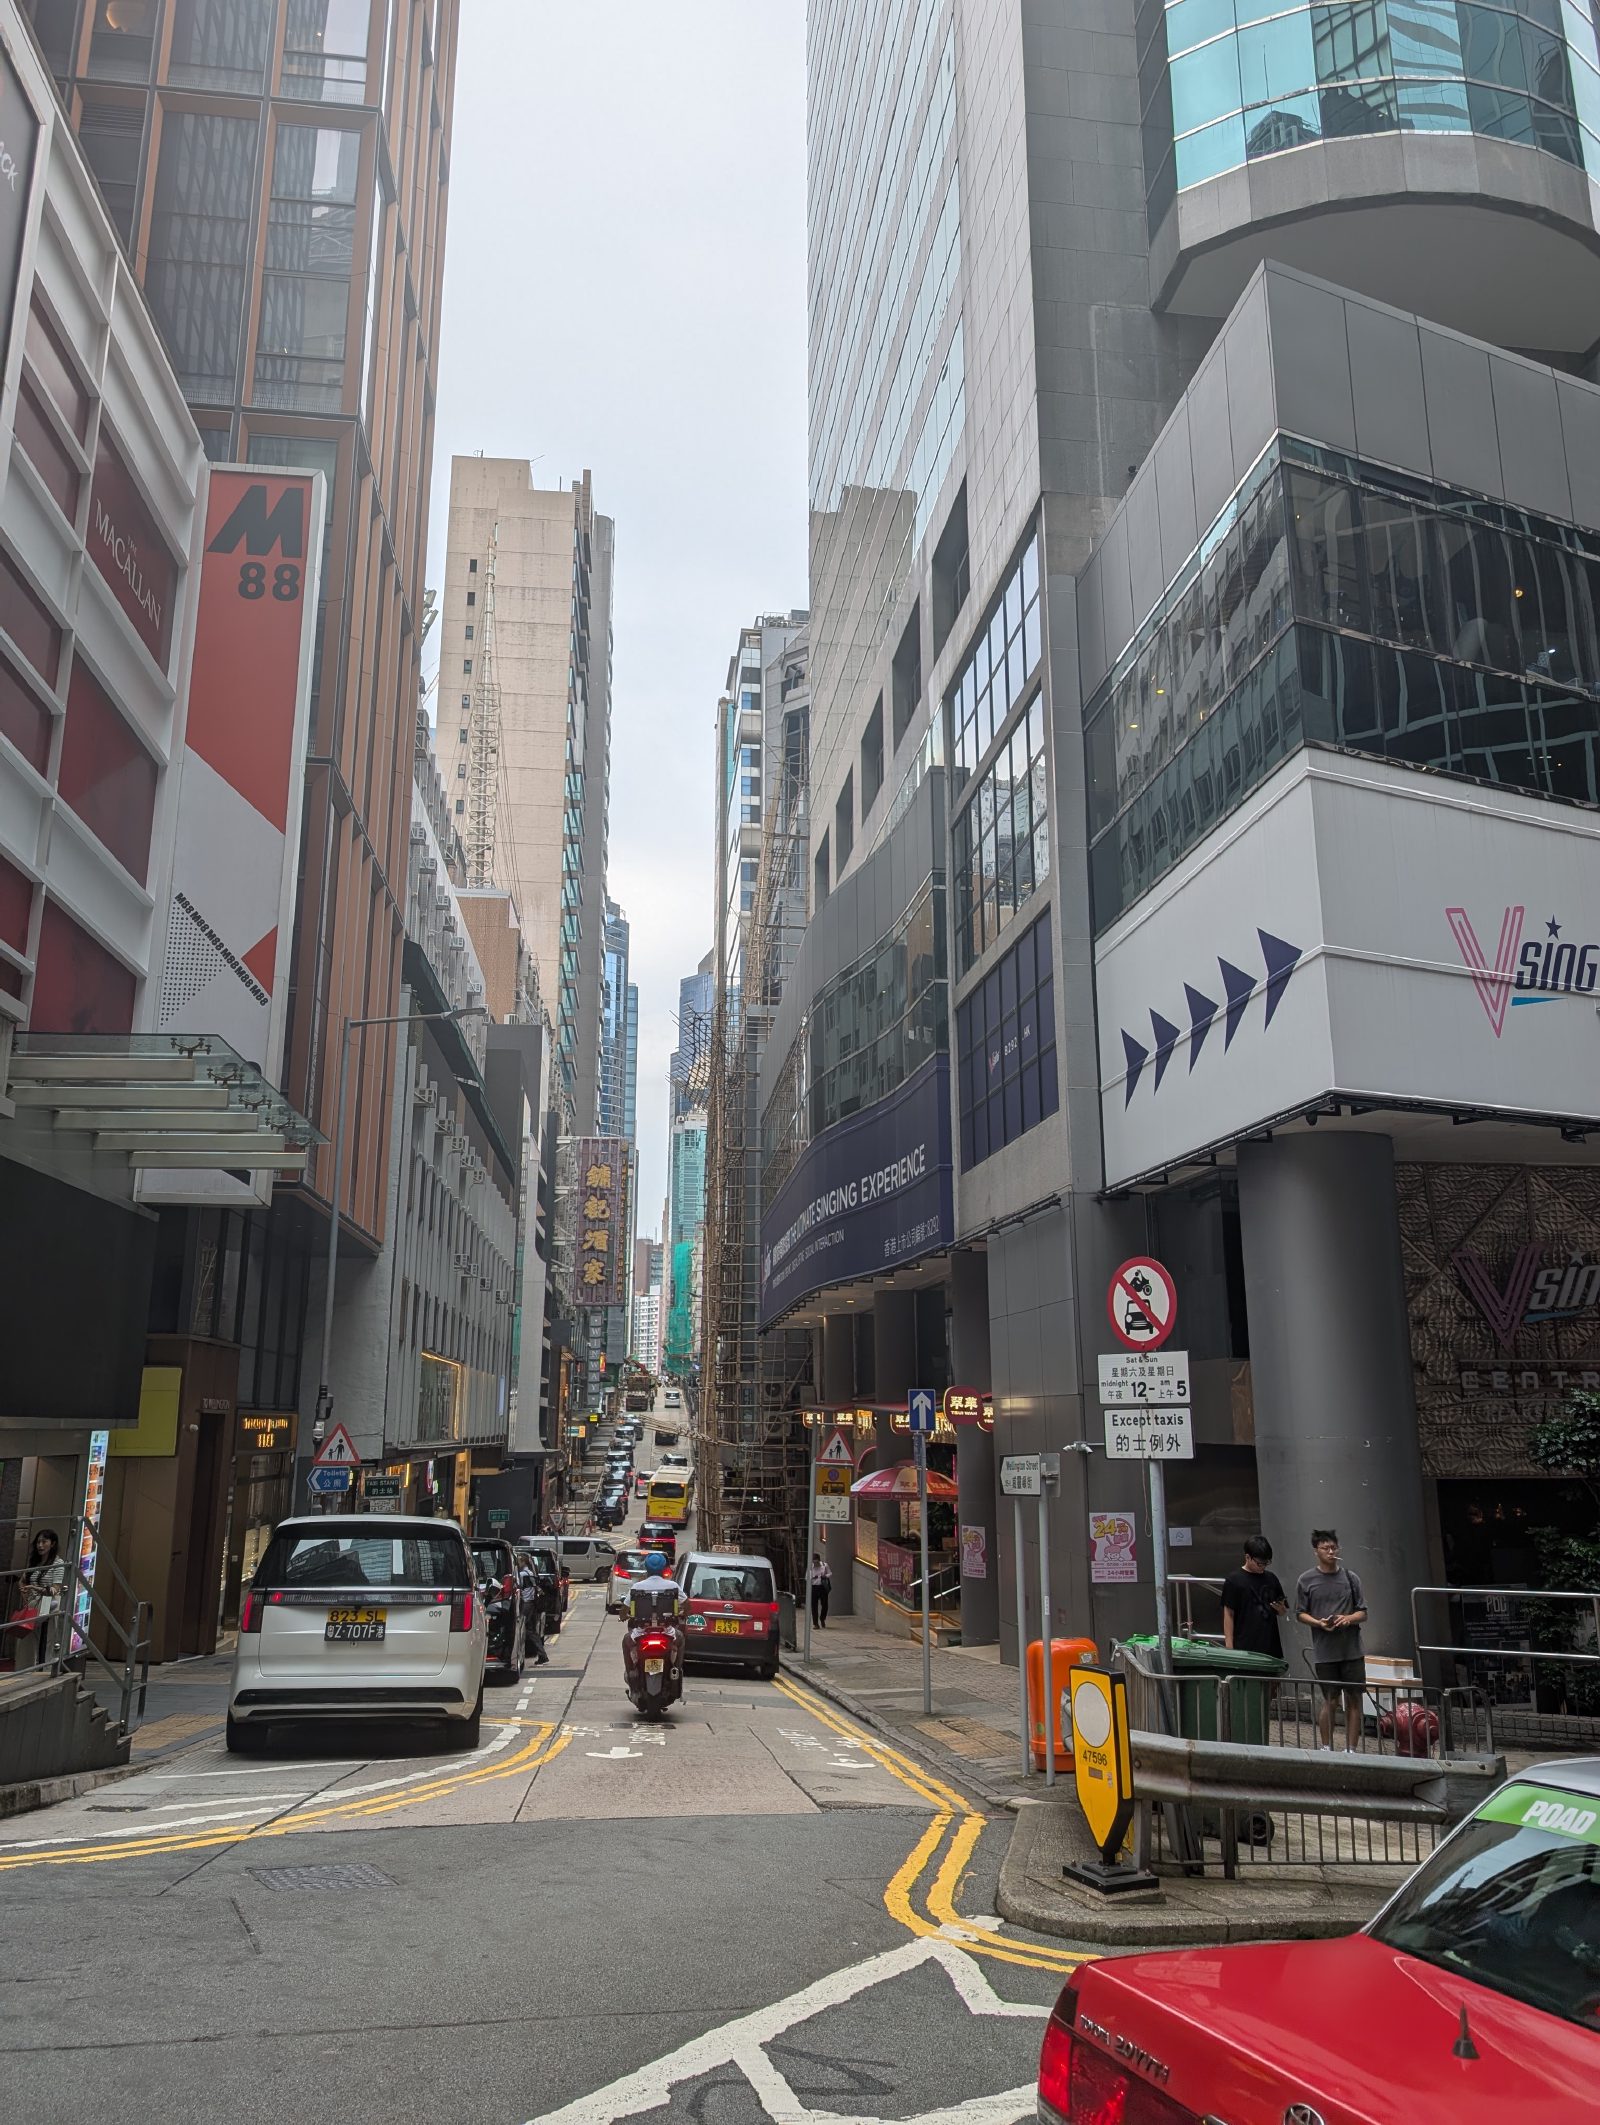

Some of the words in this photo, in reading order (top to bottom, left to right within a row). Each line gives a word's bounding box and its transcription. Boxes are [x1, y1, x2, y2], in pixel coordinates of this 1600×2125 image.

[206, 485, 304, 558] M
[95, 498, 162, 631] MACALLAN
[238, 561, 300, 601] 88
[174, 892, 195, 915] M88
[190, 911, 210, 933] M88
[205, 929, 225, 951] M88
[220, 948, 240, 970] M88
[235, 966, 254, 988] M88
[249, 984, 269, 1007] M88
[816, 1182, 858, 1223] SINGING
[861, 1143, 926, 1203] EXPERIENCE
[581, 1163, 613, 1286] 鏞記酒家
[590, 1328, 601, 1392] WINWAY
[1126, 1356, 1138, 1364] Sat
[1144, 1355, 1159, 1363] Sun
[1111, 1366, 1175, 1378] 星期六及星期日
[1101, 1380, 1129, 1388] midnight
[1176, 1380, 1187, 1397] 5
[1107, 1390, 1124, 1400] 午夜
[1158, 1389, 1175, 1400] 上午
[949, 1395, 978, 1411] 翠華
[1111, 1413, 1152, 1428] Except
[1154, 1413, 1184, 1426] taxis
[1115, 1433, 1182, 1453] 的士例外
[1006, 1460, 1026, 1472] Wellington
[836, 1497, 843, 1506] 7
[836, 1510, 847, 1519] 12
[1094, 1519, 1117, 1539] 24
[329, 1610, 359, 1622] 823
[365, 1610, 384, 1622] SL
[1521, 1800, 1597, 1835] POAD
[1080, 2014, 1111, 2047] TOYOTA
